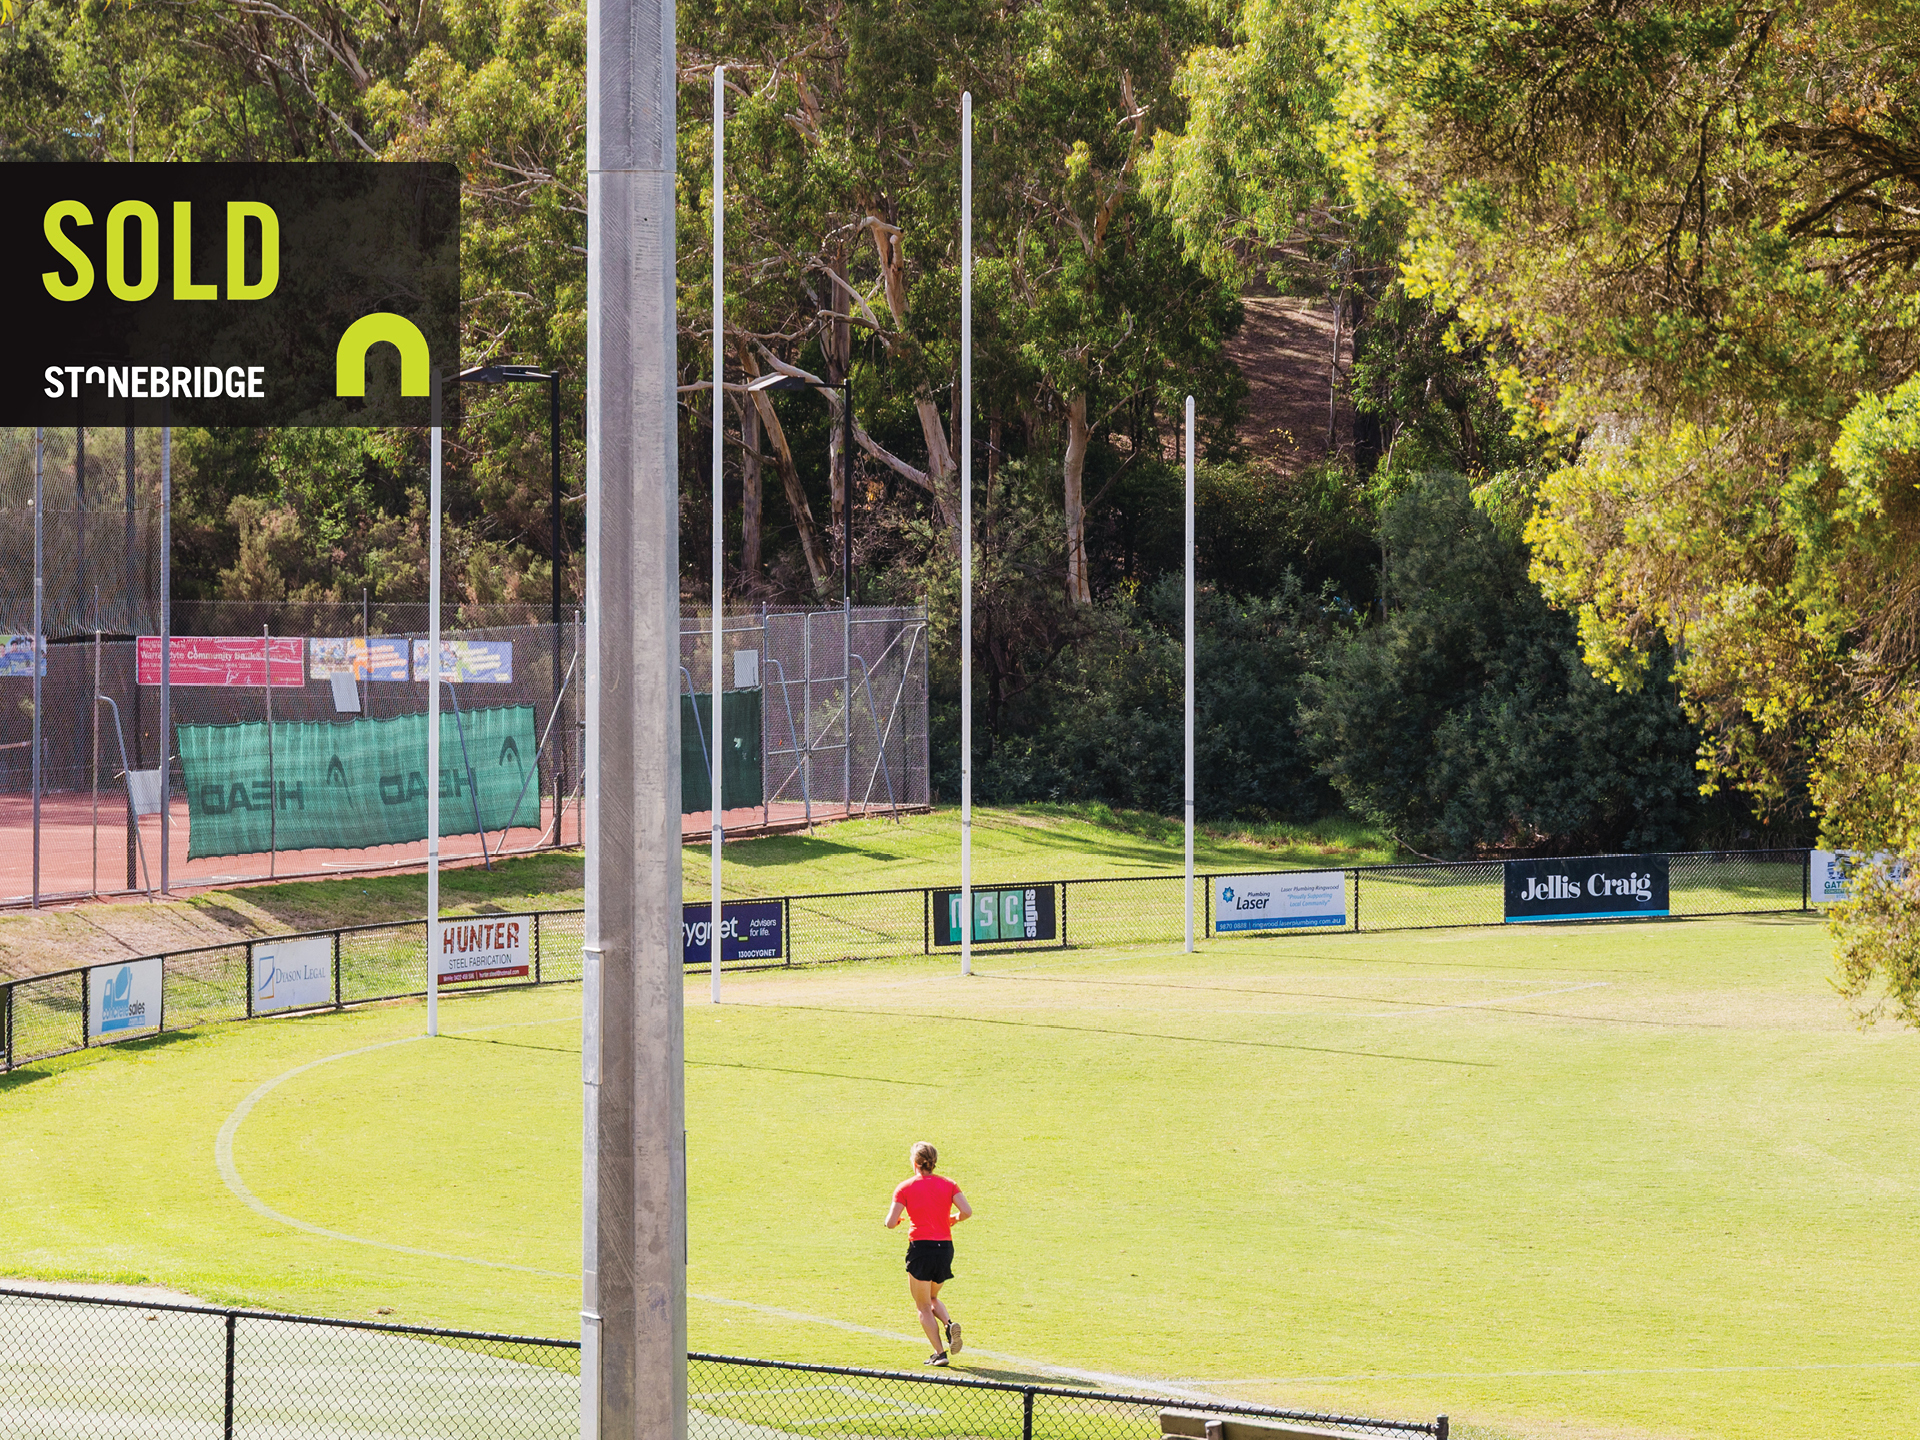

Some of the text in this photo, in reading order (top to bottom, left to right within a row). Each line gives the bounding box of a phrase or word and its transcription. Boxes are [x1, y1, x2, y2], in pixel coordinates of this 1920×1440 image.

[187, 651, 232, 661] Community
[1521, 871, 1652, 902] Jellis Craig
[1236, 896, 1270, 910] Laser
[1024, 889, 1039, 938] signs
[749, 918, 777, 928] Advisors
[1252, 918, 1341, 930] ringwood.laserplumbing.com.au
[443, 922, 520, 955] HUNTER
[749, 927, 771, 937] for life.
[738, 949, 776, 958] 1300CYGNET
[448, 954, 512, 970] STEEL FABRICATION
